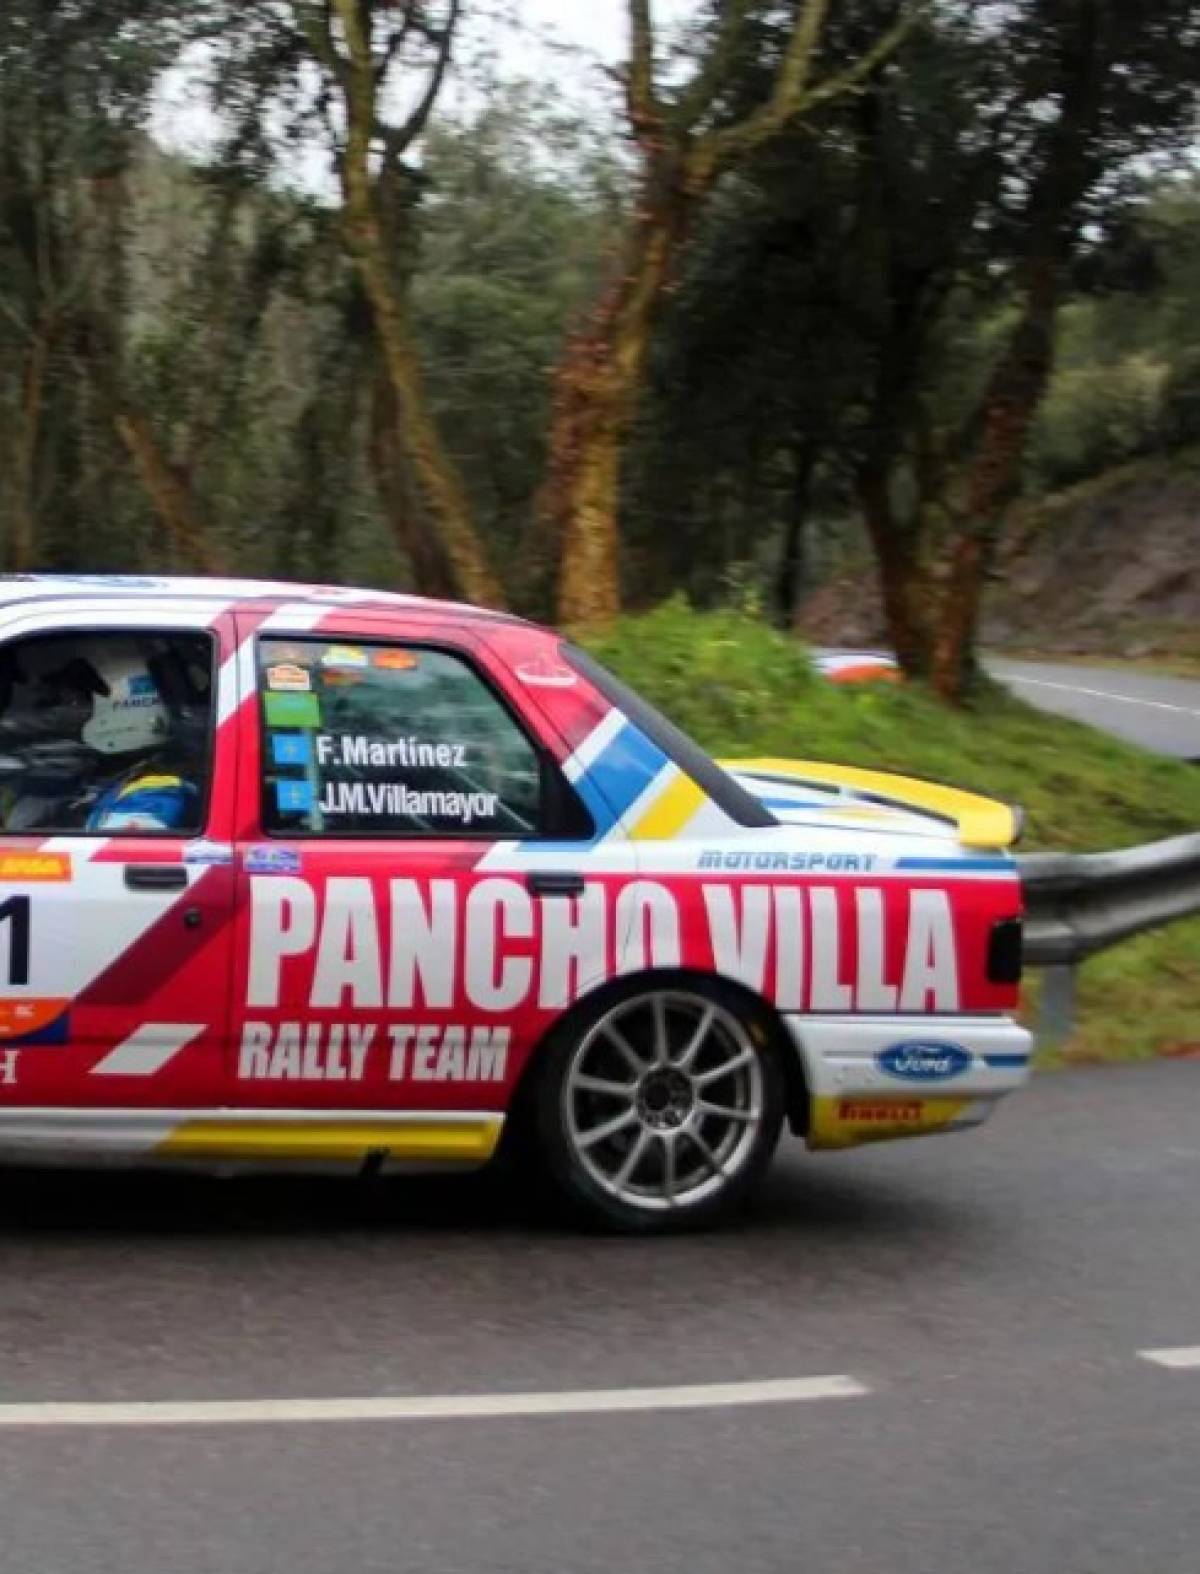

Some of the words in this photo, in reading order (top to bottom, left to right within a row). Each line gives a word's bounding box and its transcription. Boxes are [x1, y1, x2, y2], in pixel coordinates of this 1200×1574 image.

[319, 781, 498, 823] J.M.Villamayor
[697, 851, 877, 872] MOTORSPORT
[246, 876, 681, 1012] PANCHO
[702, 883, 961, 1012] VILLA
[238, 1021, 378, 1081] RALLY
[387, 1023, 512, 1081] TEAM
[894, 1045, 952, 1072] Ford
[838, 1100, 924, 1121] PIRELLI
